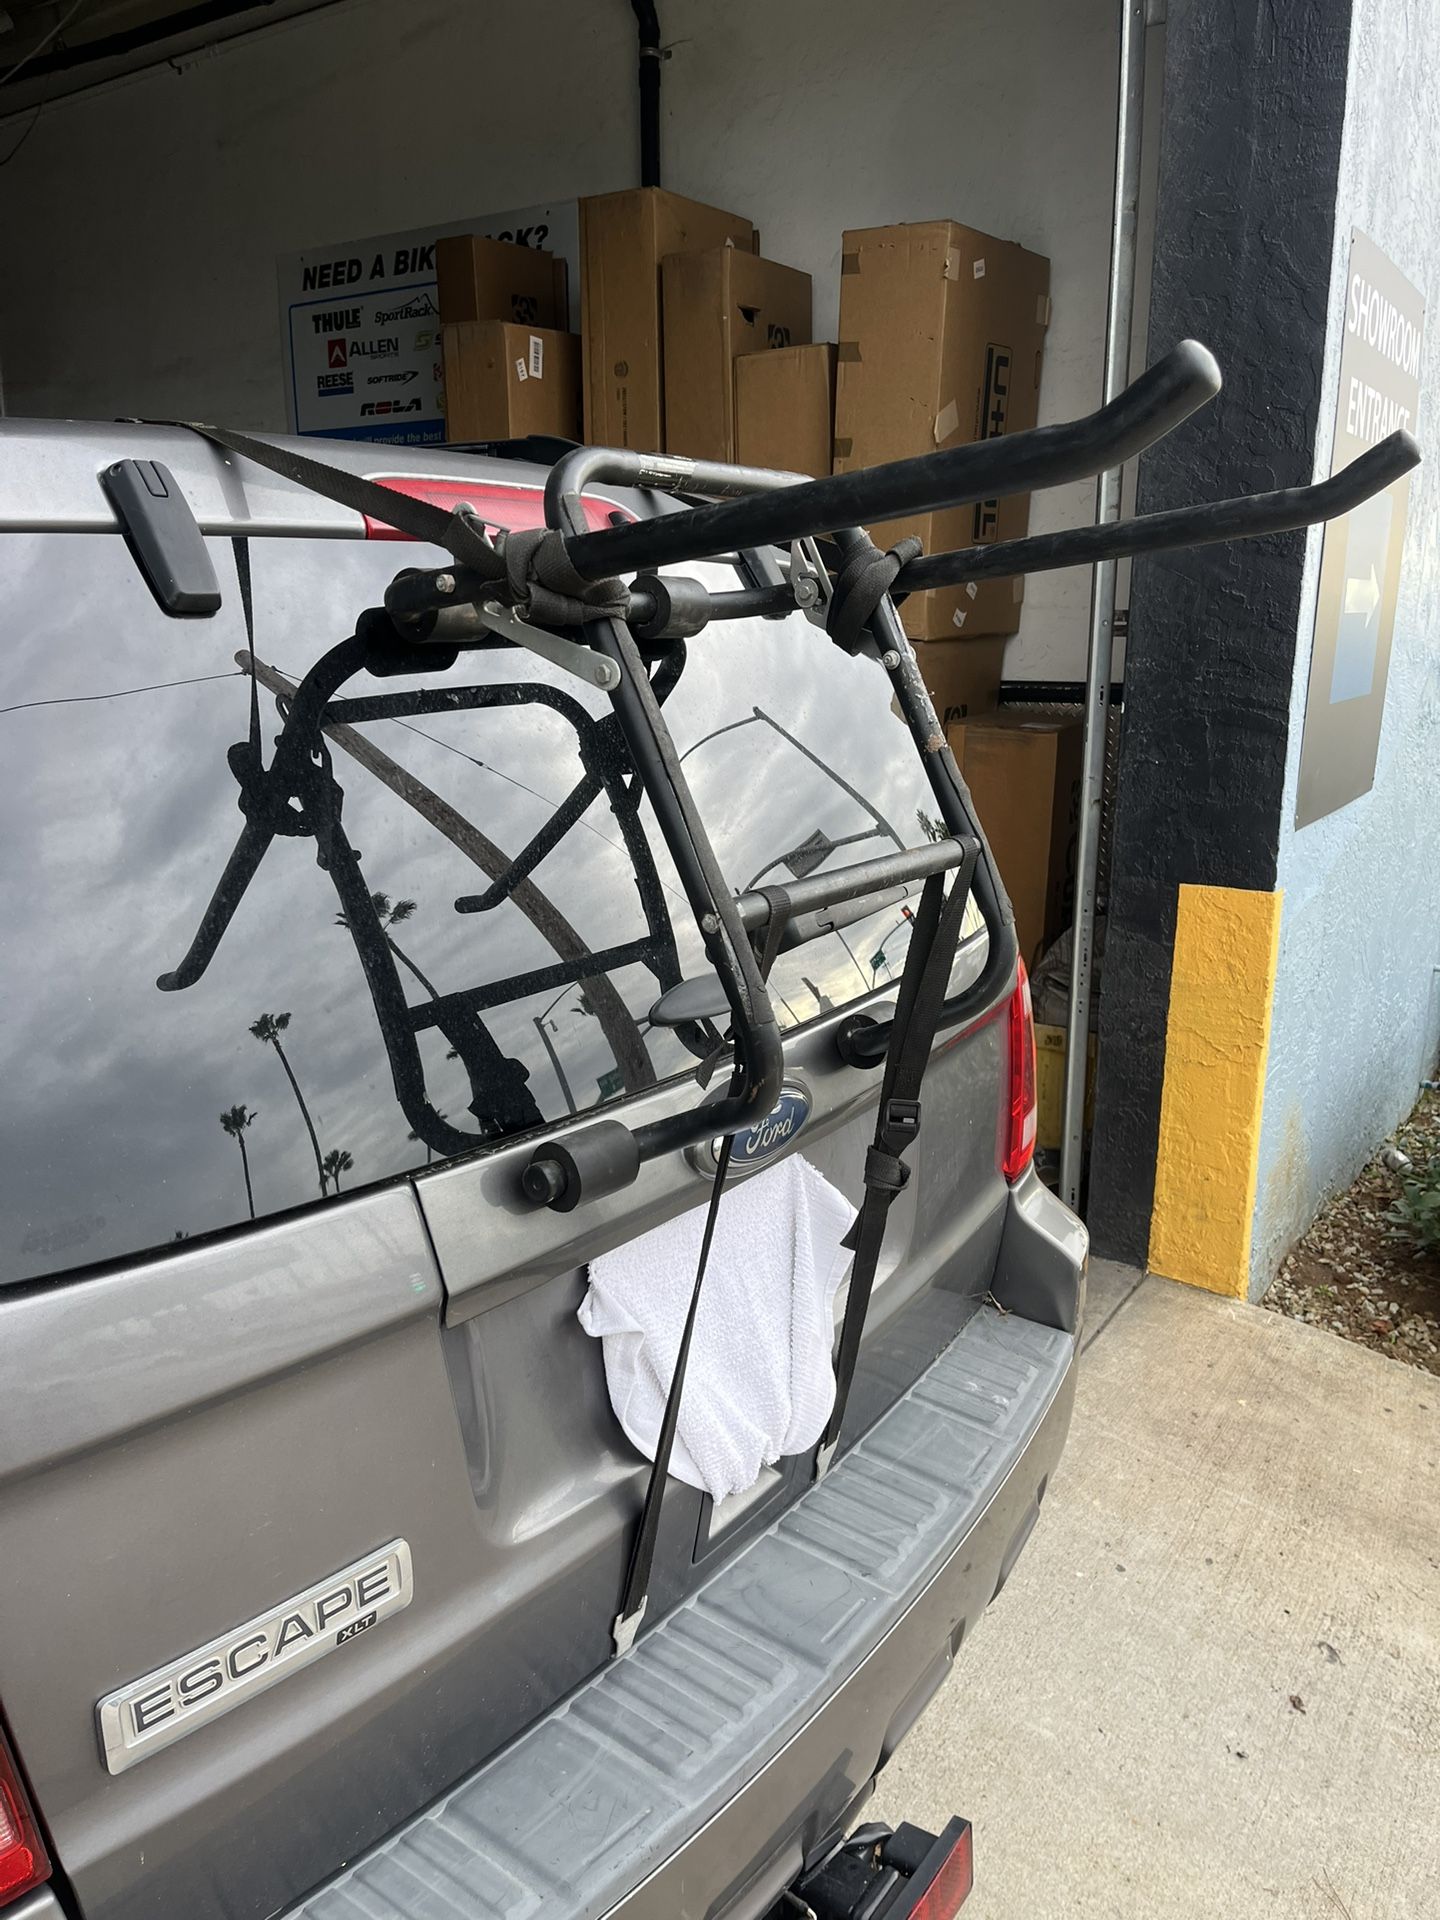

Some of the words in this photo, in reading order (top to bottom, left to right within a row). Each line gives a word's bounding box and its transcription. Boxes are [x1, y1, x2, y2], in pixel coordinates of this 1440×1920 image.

[302, 258, 362, 291] NEED
[369, 254, 384, 280] A
[394, 245, 436, 276] BIK
[312, 308, 361, 333] THULE
[375, 303, 432, 325] SportRack
[1348, 273, 1421, 379] SHOWROOM
[350, 337, 399, 357] ALLEN
[317, 372, 354, 388] REESE
[407, 432, 421, 443] the
[423, 431, 442, 442] best
[745, 1104, 796, 1155] Ford
[341, 1614, 373, 1641] XLT
[130, 1561, 391, 1735] ESCAPE
